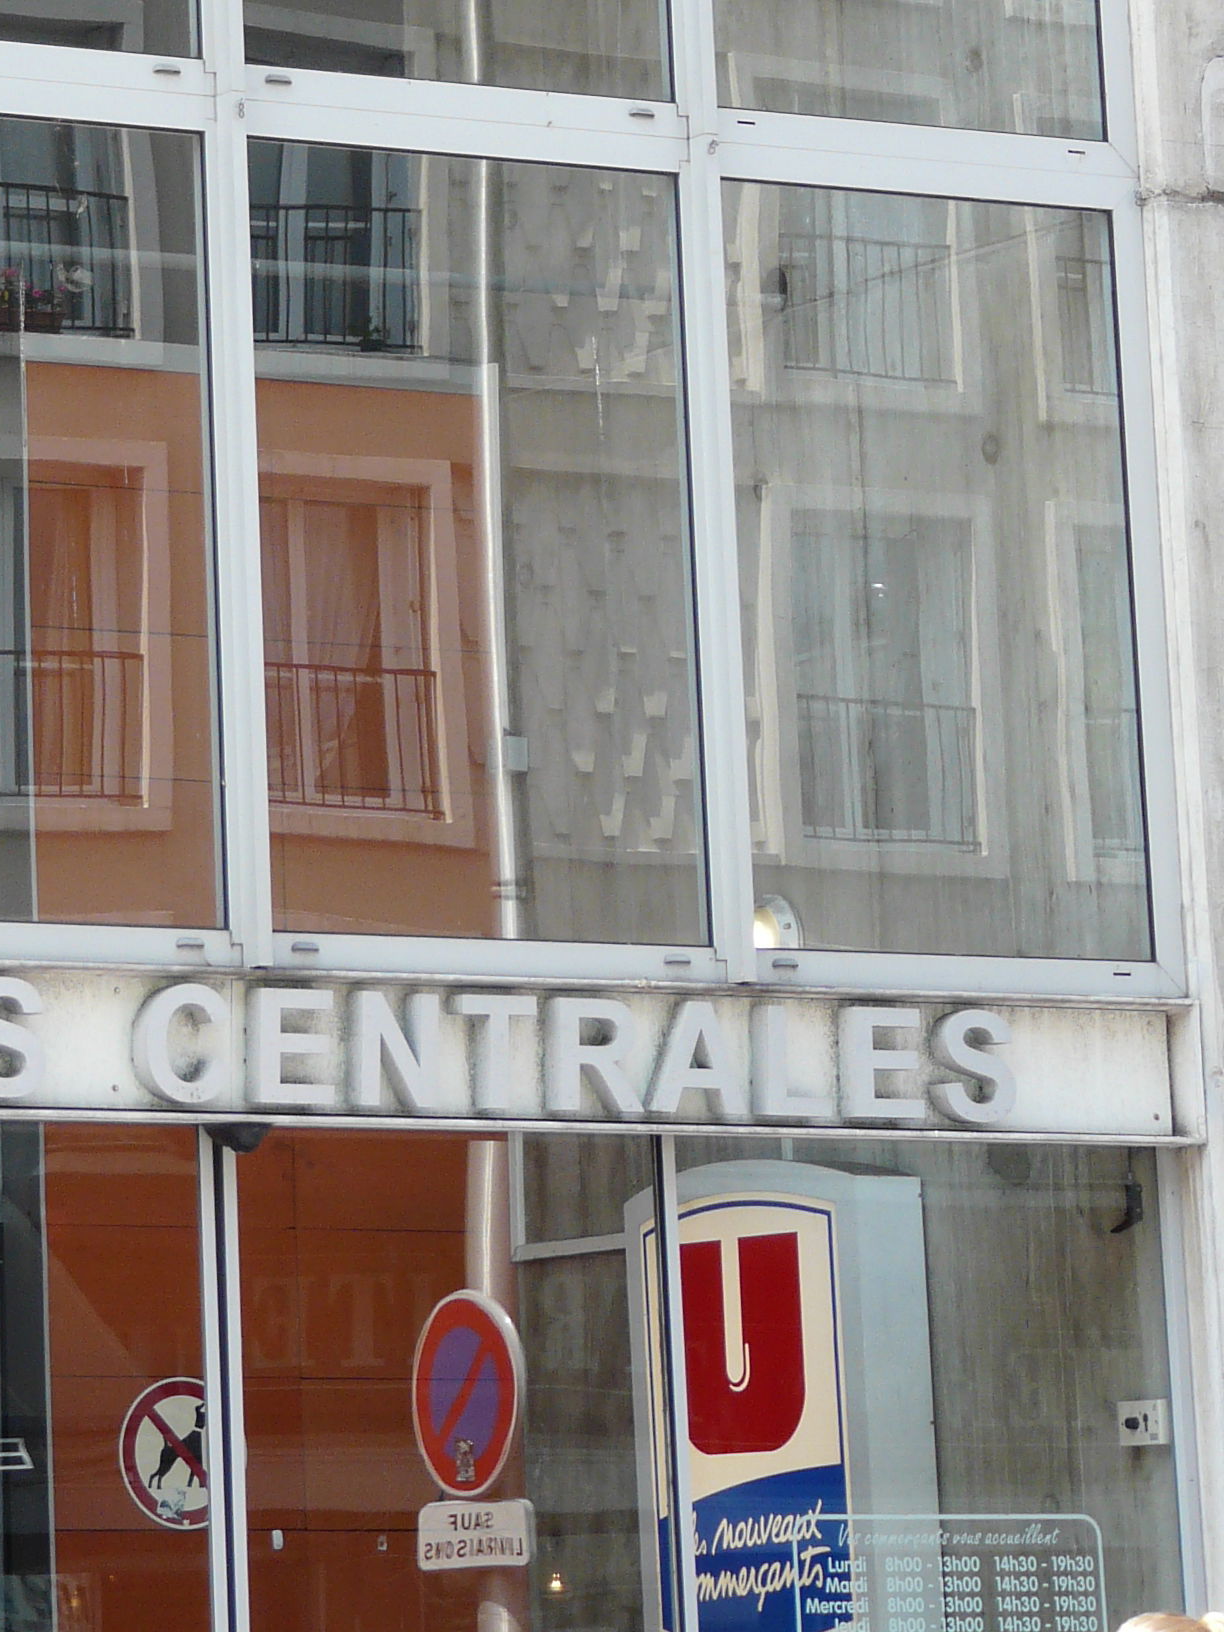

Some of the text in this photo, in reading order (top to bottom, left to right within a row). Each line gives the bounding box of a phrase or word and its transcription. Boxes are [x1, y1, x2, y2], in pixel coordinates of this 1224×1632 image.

[133, 982, 1017, 1124] CENTRALES
[985, 1523, 1060, 1546] accueillent
[828, 1556, 867, 1572] Lundi
[885, 1556, 922, 1572] 8h00
[938, 1556, 980, 1572] 13h00
[993, 1556, 1037, 1572] 14h30
[1051, 1556, 1094, 1572] 19h30
[826, 1576, 868, 1593] Mardi
[886, 1576, 923, 1593] 8h00
[939, 1576, 981, 1593] 13h00
[994, 1576, 1038, 1593] 14h30
[1052, 1576, 1095, 1593] 19h30
[805, 1597, 869, 1614] Mercredi
[888, 1597, 925, 1614] 8h00
[941, 1597, 983, 1614] 13h00
[996, 1597, 1040, 1614] 14h30
[1054, 1597, 1097, 1614] 19h30
